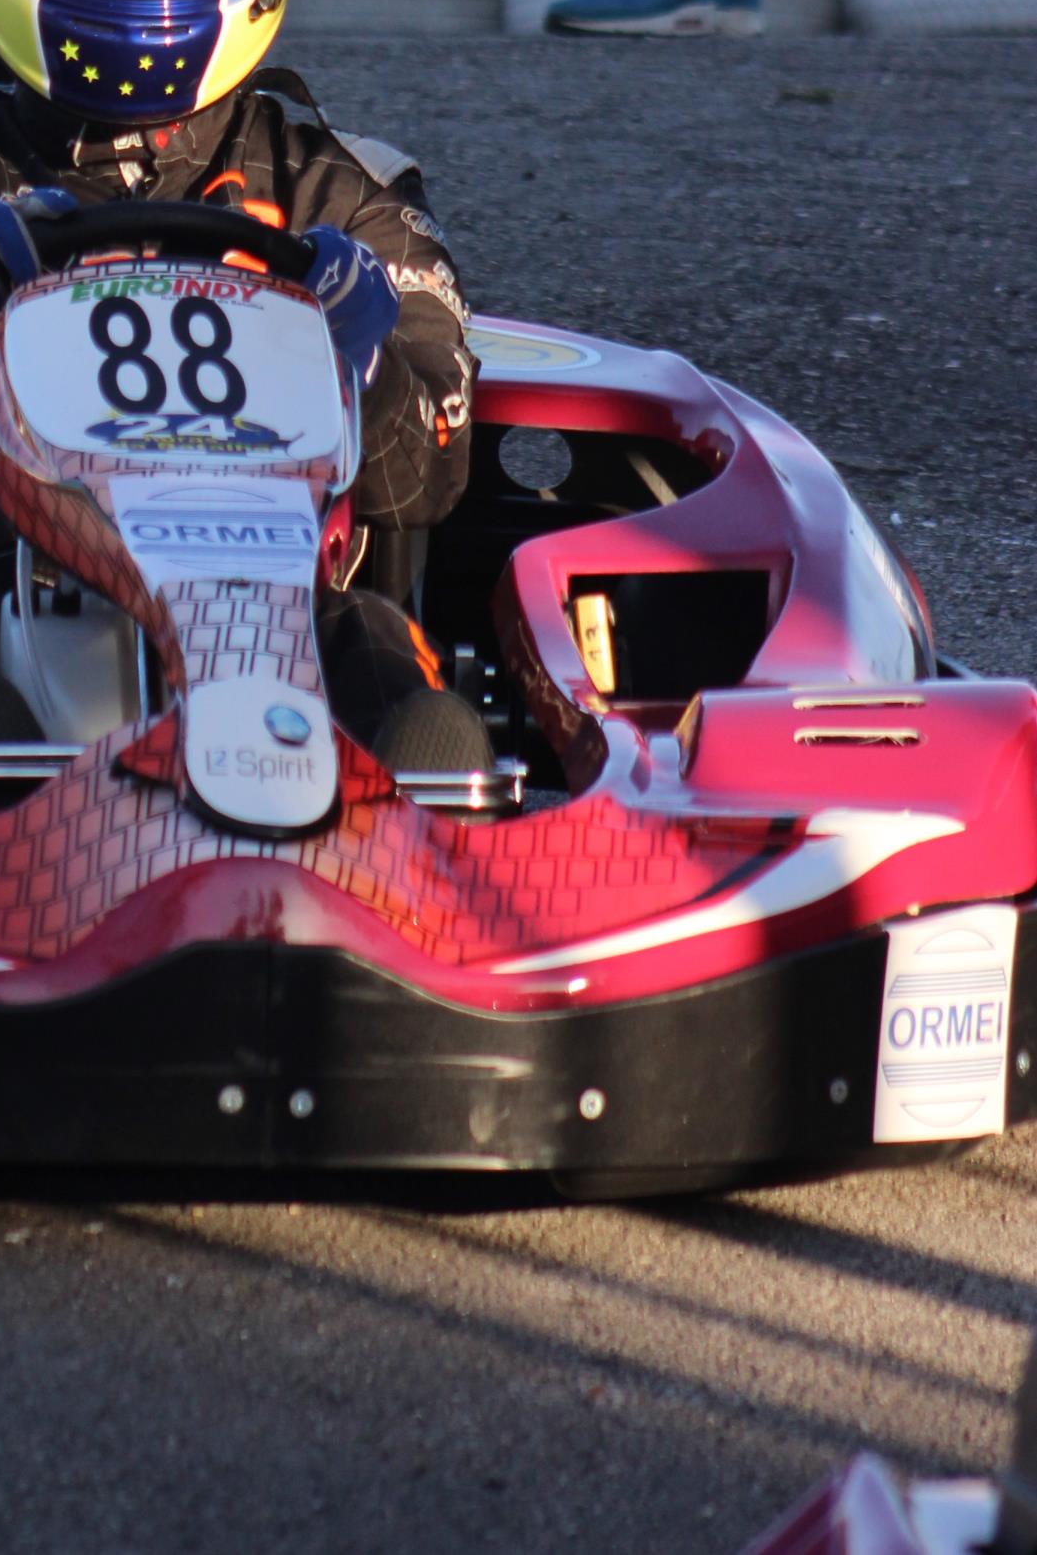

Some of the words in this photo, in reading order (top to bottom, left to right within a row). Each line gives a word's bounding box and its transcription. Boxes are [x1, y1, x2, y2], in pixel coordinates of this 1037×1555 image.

[70, 277, 262, 304] EUROINDY
[88, 295, 247, 417] 88
[114, 414, 236, 441] 24
[130, 523, 314, 545] ORMEI
[235, 747, 317, 784] Spirit
[887, 1000, 1004, 1050] ORMEI
